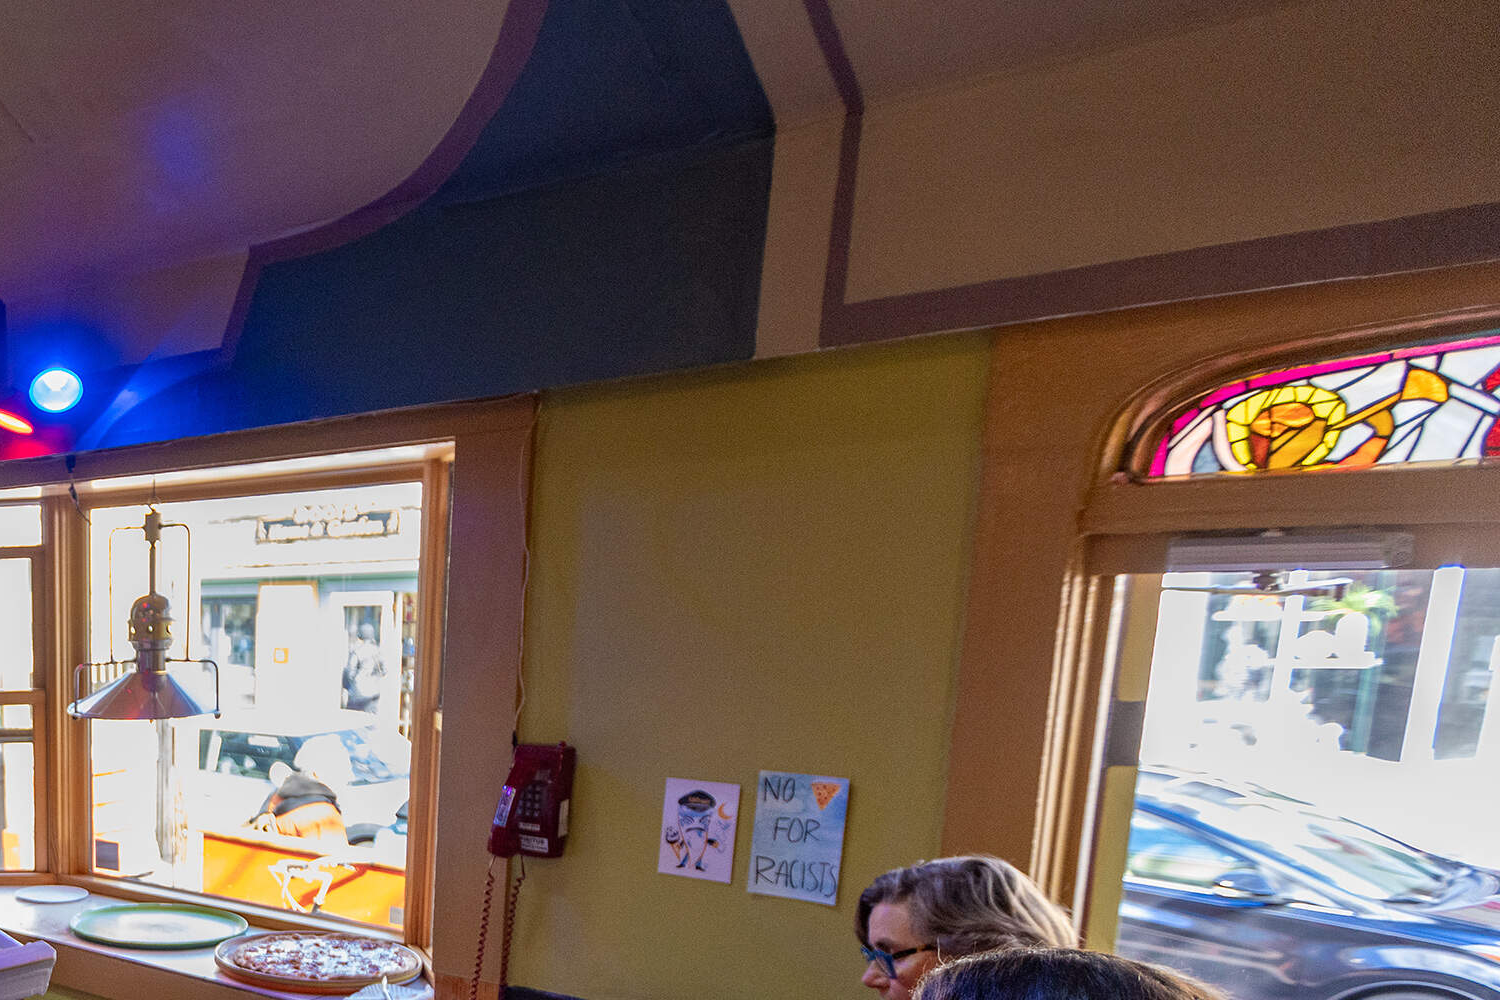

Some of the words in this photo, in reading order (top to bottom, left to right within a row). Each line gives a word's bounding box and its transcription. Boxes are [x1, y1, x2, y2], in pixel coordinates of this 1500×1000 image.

[763, 776, 797, 803] NO
[773, 817, 821, 843] FOR
[755, 856, 838, 898] RACISTS
